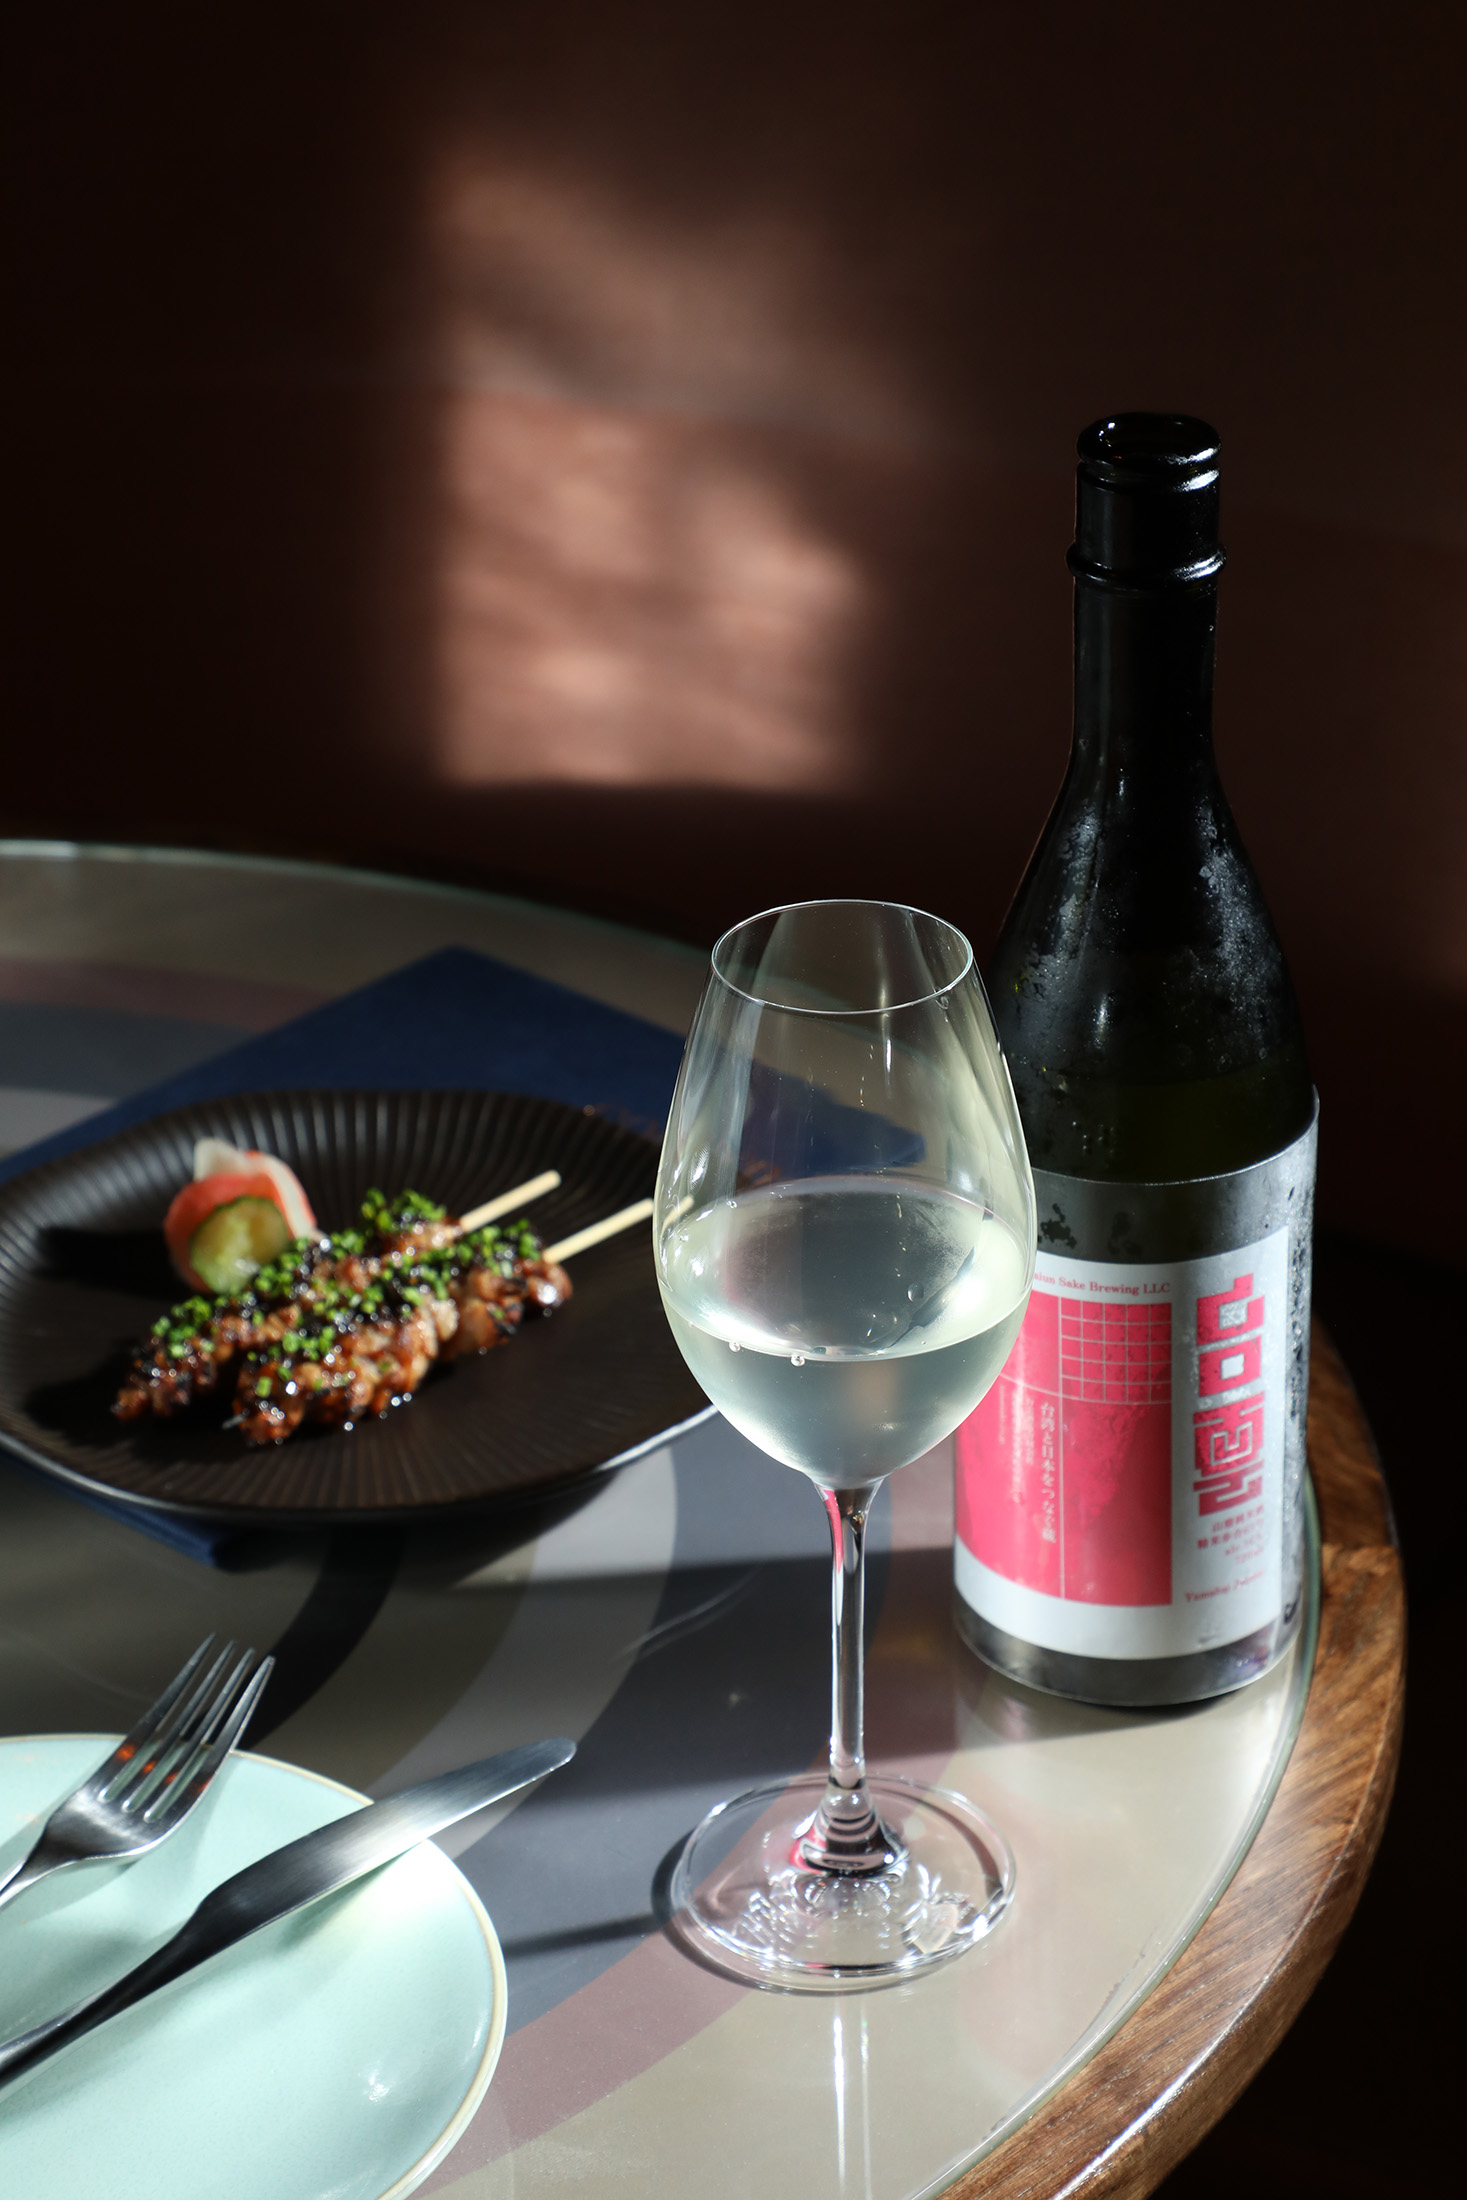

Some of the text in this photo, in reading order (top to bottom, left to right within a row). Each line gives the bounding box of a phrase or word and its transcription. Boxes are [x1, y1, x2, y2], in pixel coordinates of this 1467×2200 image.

[1033, 1272, 1170, 1296] aiun Sake Brewing LLC
